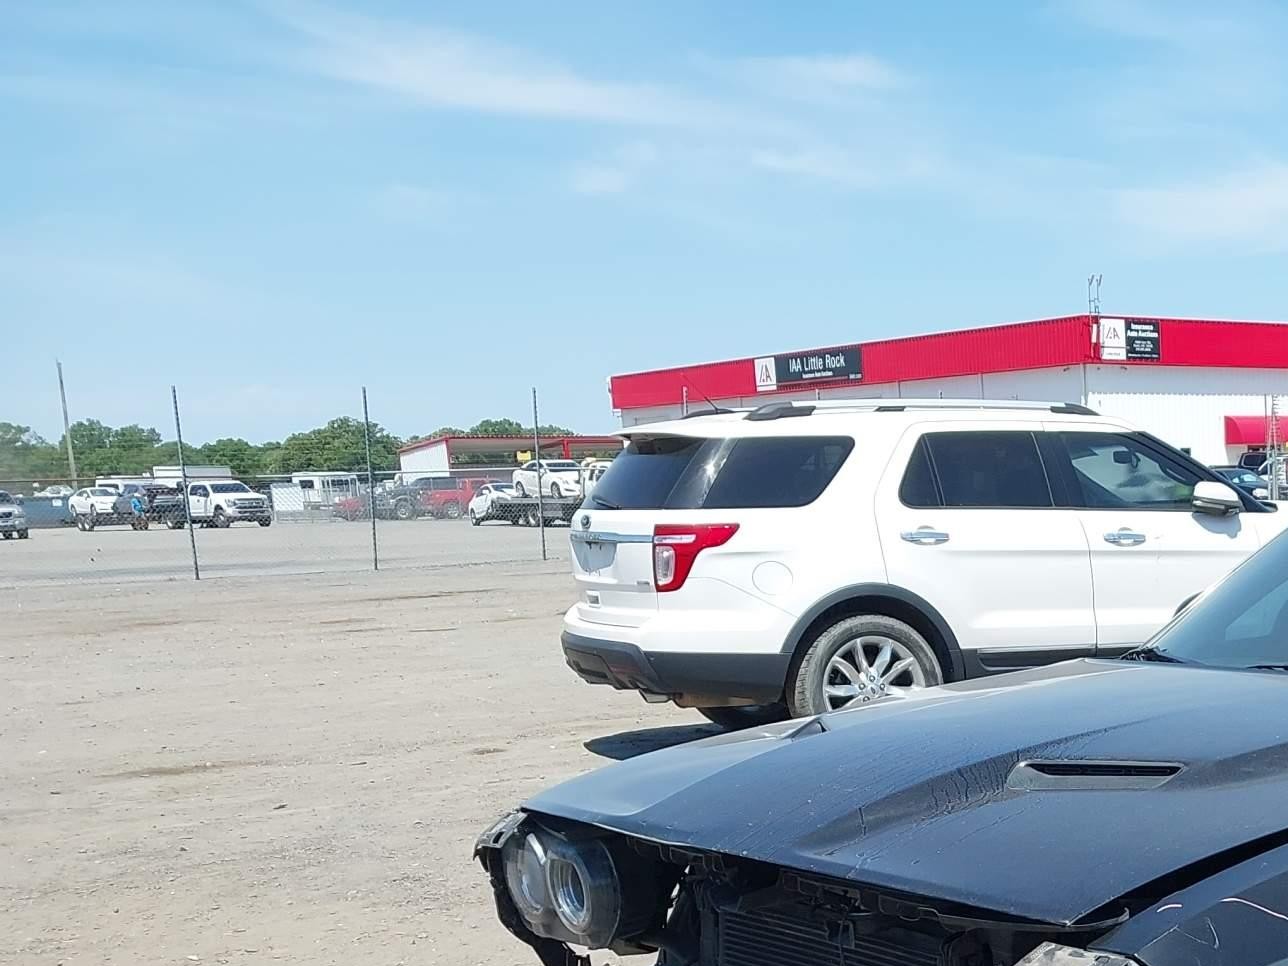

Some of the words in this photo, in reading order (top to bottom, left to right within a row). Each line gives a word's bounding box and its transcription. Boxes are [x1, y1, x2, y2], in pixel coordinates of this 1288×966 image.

[788, 358, 802, 373] IAA
[803, 356, 824, 371] Little
[825, 353, 846, 369] Rock
